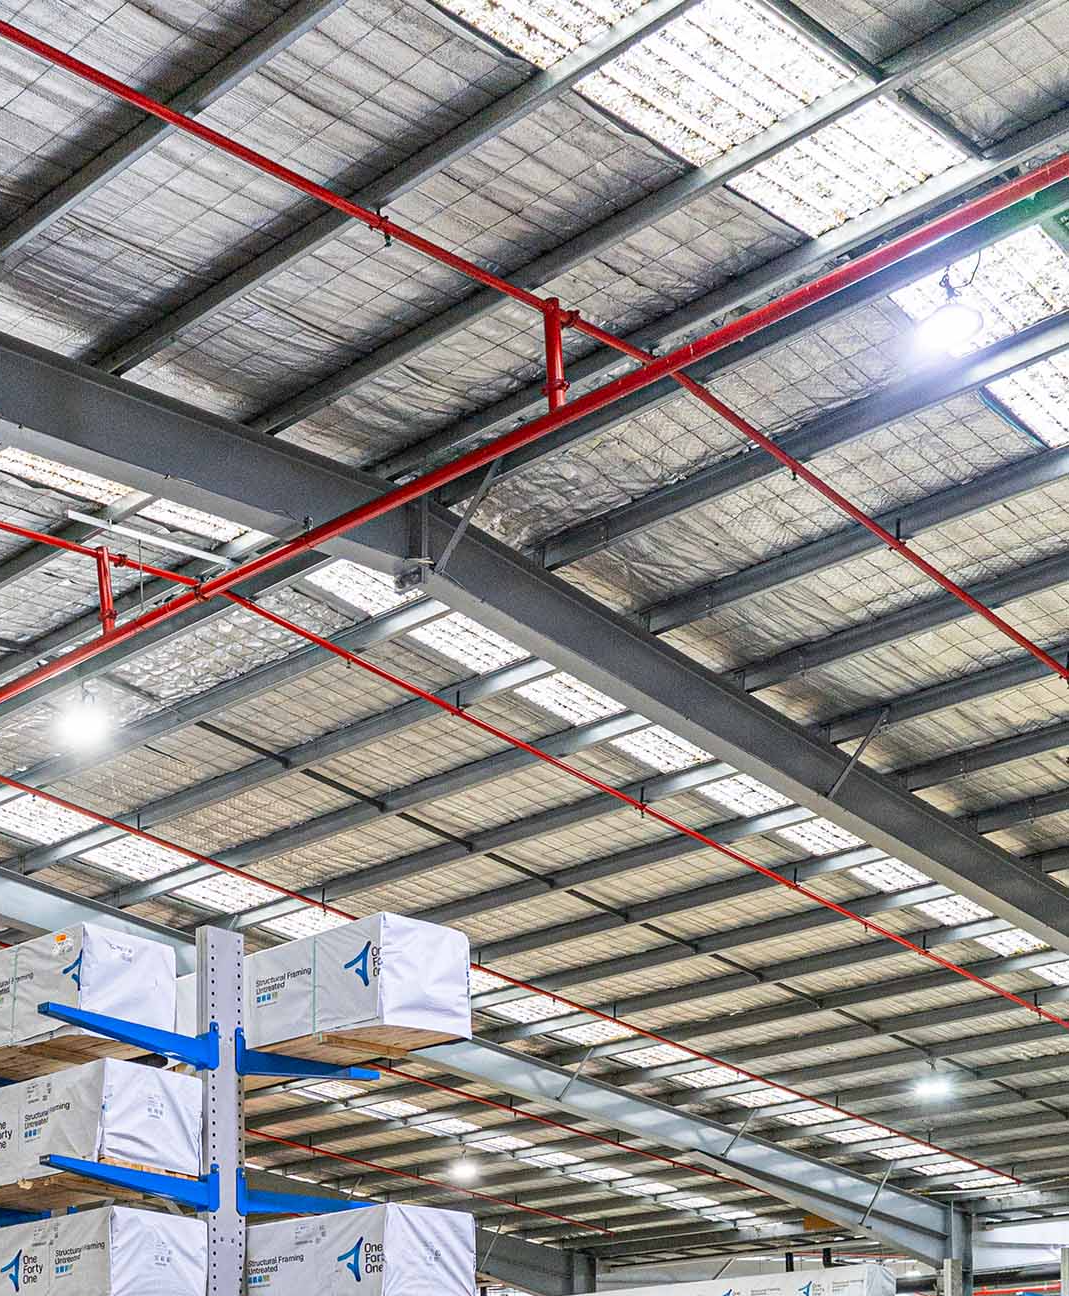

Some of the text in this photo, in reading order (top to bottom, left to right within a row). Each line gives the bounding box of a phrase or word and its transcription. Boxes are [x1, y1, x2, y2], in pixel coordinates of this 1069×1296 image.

[256, 967, 312, 988] Structural Framing
[256, 981, 285, 995] Untreated
[364, 1242, 384, 1253] One
[22, 1255, 38, 1265] One
[248, 1254, 305, 1267] Structural Framing
[365, 1252, 385, 1264] Fort
[23, 1263, 43, 1275] Forty
[248, 1265, 278, 1275] Untreated
[365, 1263, 383, 1274] One
[22, 1274, 38, 1285] One
